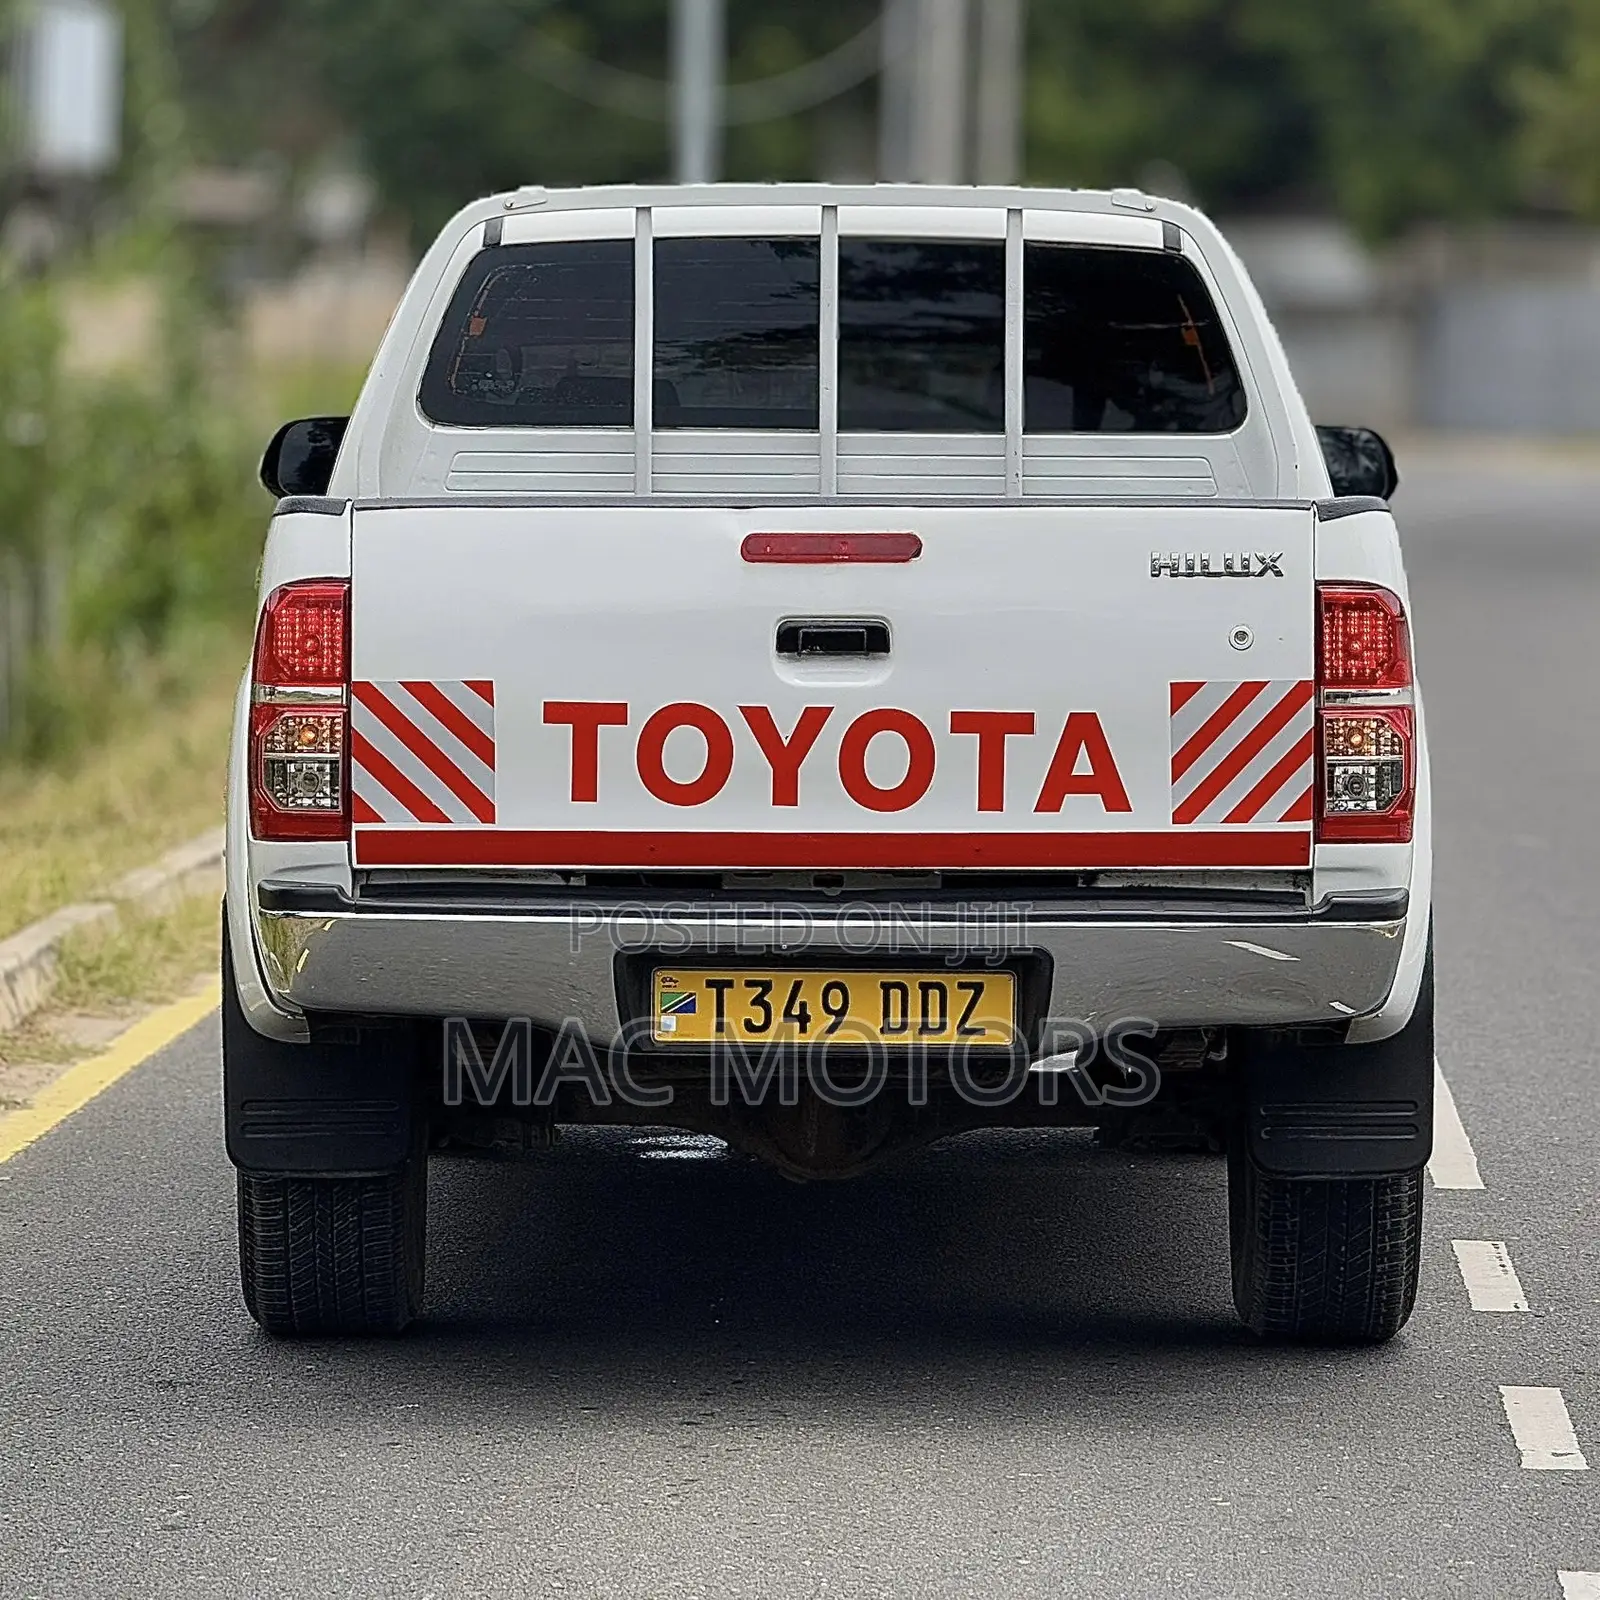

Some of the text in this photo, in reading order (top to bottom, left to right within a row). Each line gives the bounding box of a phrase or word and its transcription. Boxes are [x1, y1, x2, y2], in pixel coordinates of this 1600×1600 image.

[1150, 551, 1284, 577] HILUX
[542, 700, 1133, 813] TOYOTA
[705, 979, 986, 1035] T349 DDZ
